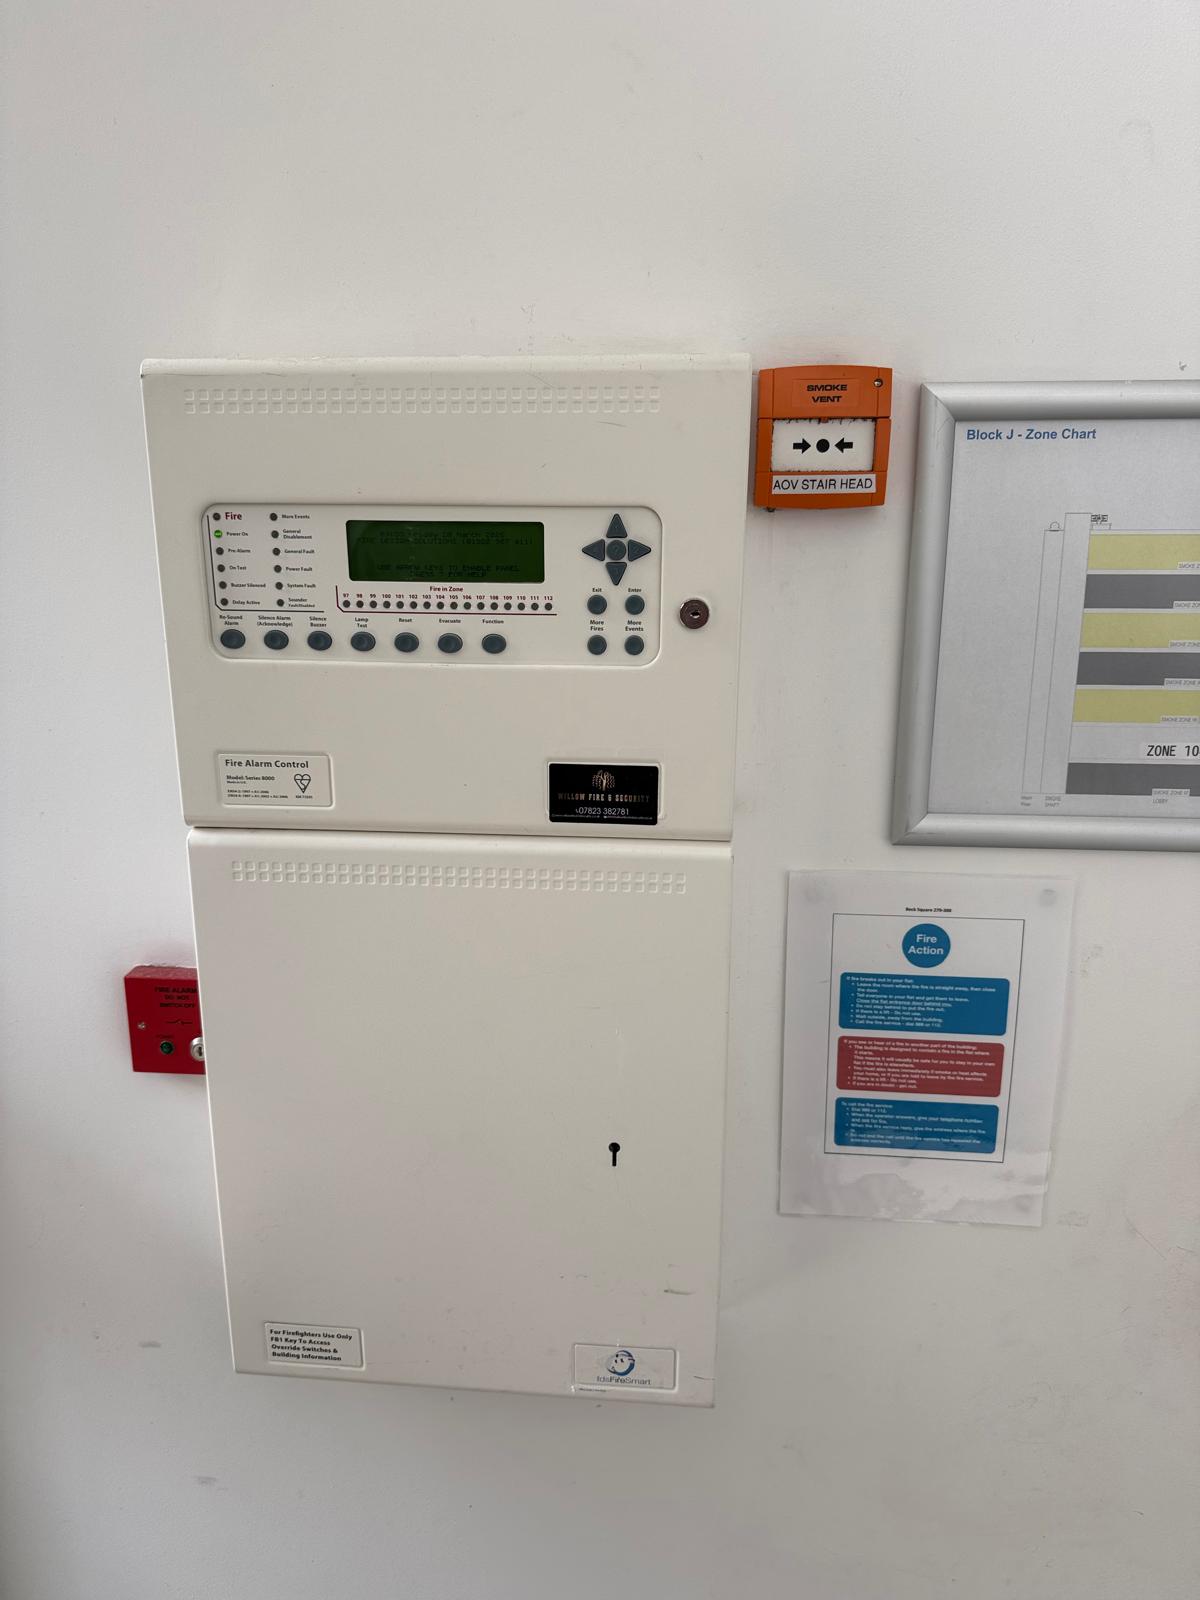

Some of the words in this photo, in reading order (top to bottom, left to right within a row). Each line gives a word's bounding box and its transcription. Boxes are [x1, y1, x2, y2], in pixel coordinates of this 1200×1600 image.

[967, 429, 1002, 440] Block
[1006, 429, 1014, 439] J
[1025, 429, 1057, 440] Zone
[1062, 428, 1096, 439] Chart
[773, 480, 798, 490] AOV
[802, 479, 837, 490] STAIR
[840, 478, 872, 489] HEAD
[225, 512, 242, 520] Fire
[1147, 745, 1176, 756] ZONE
[245, 760, 272, 768] Alarm
[275, 760, 309, 768] Control
[615, 794, 649, 802] SECURITY
[916, 934, 937, 943] Fire
[908, 945, 944, 954] Action
